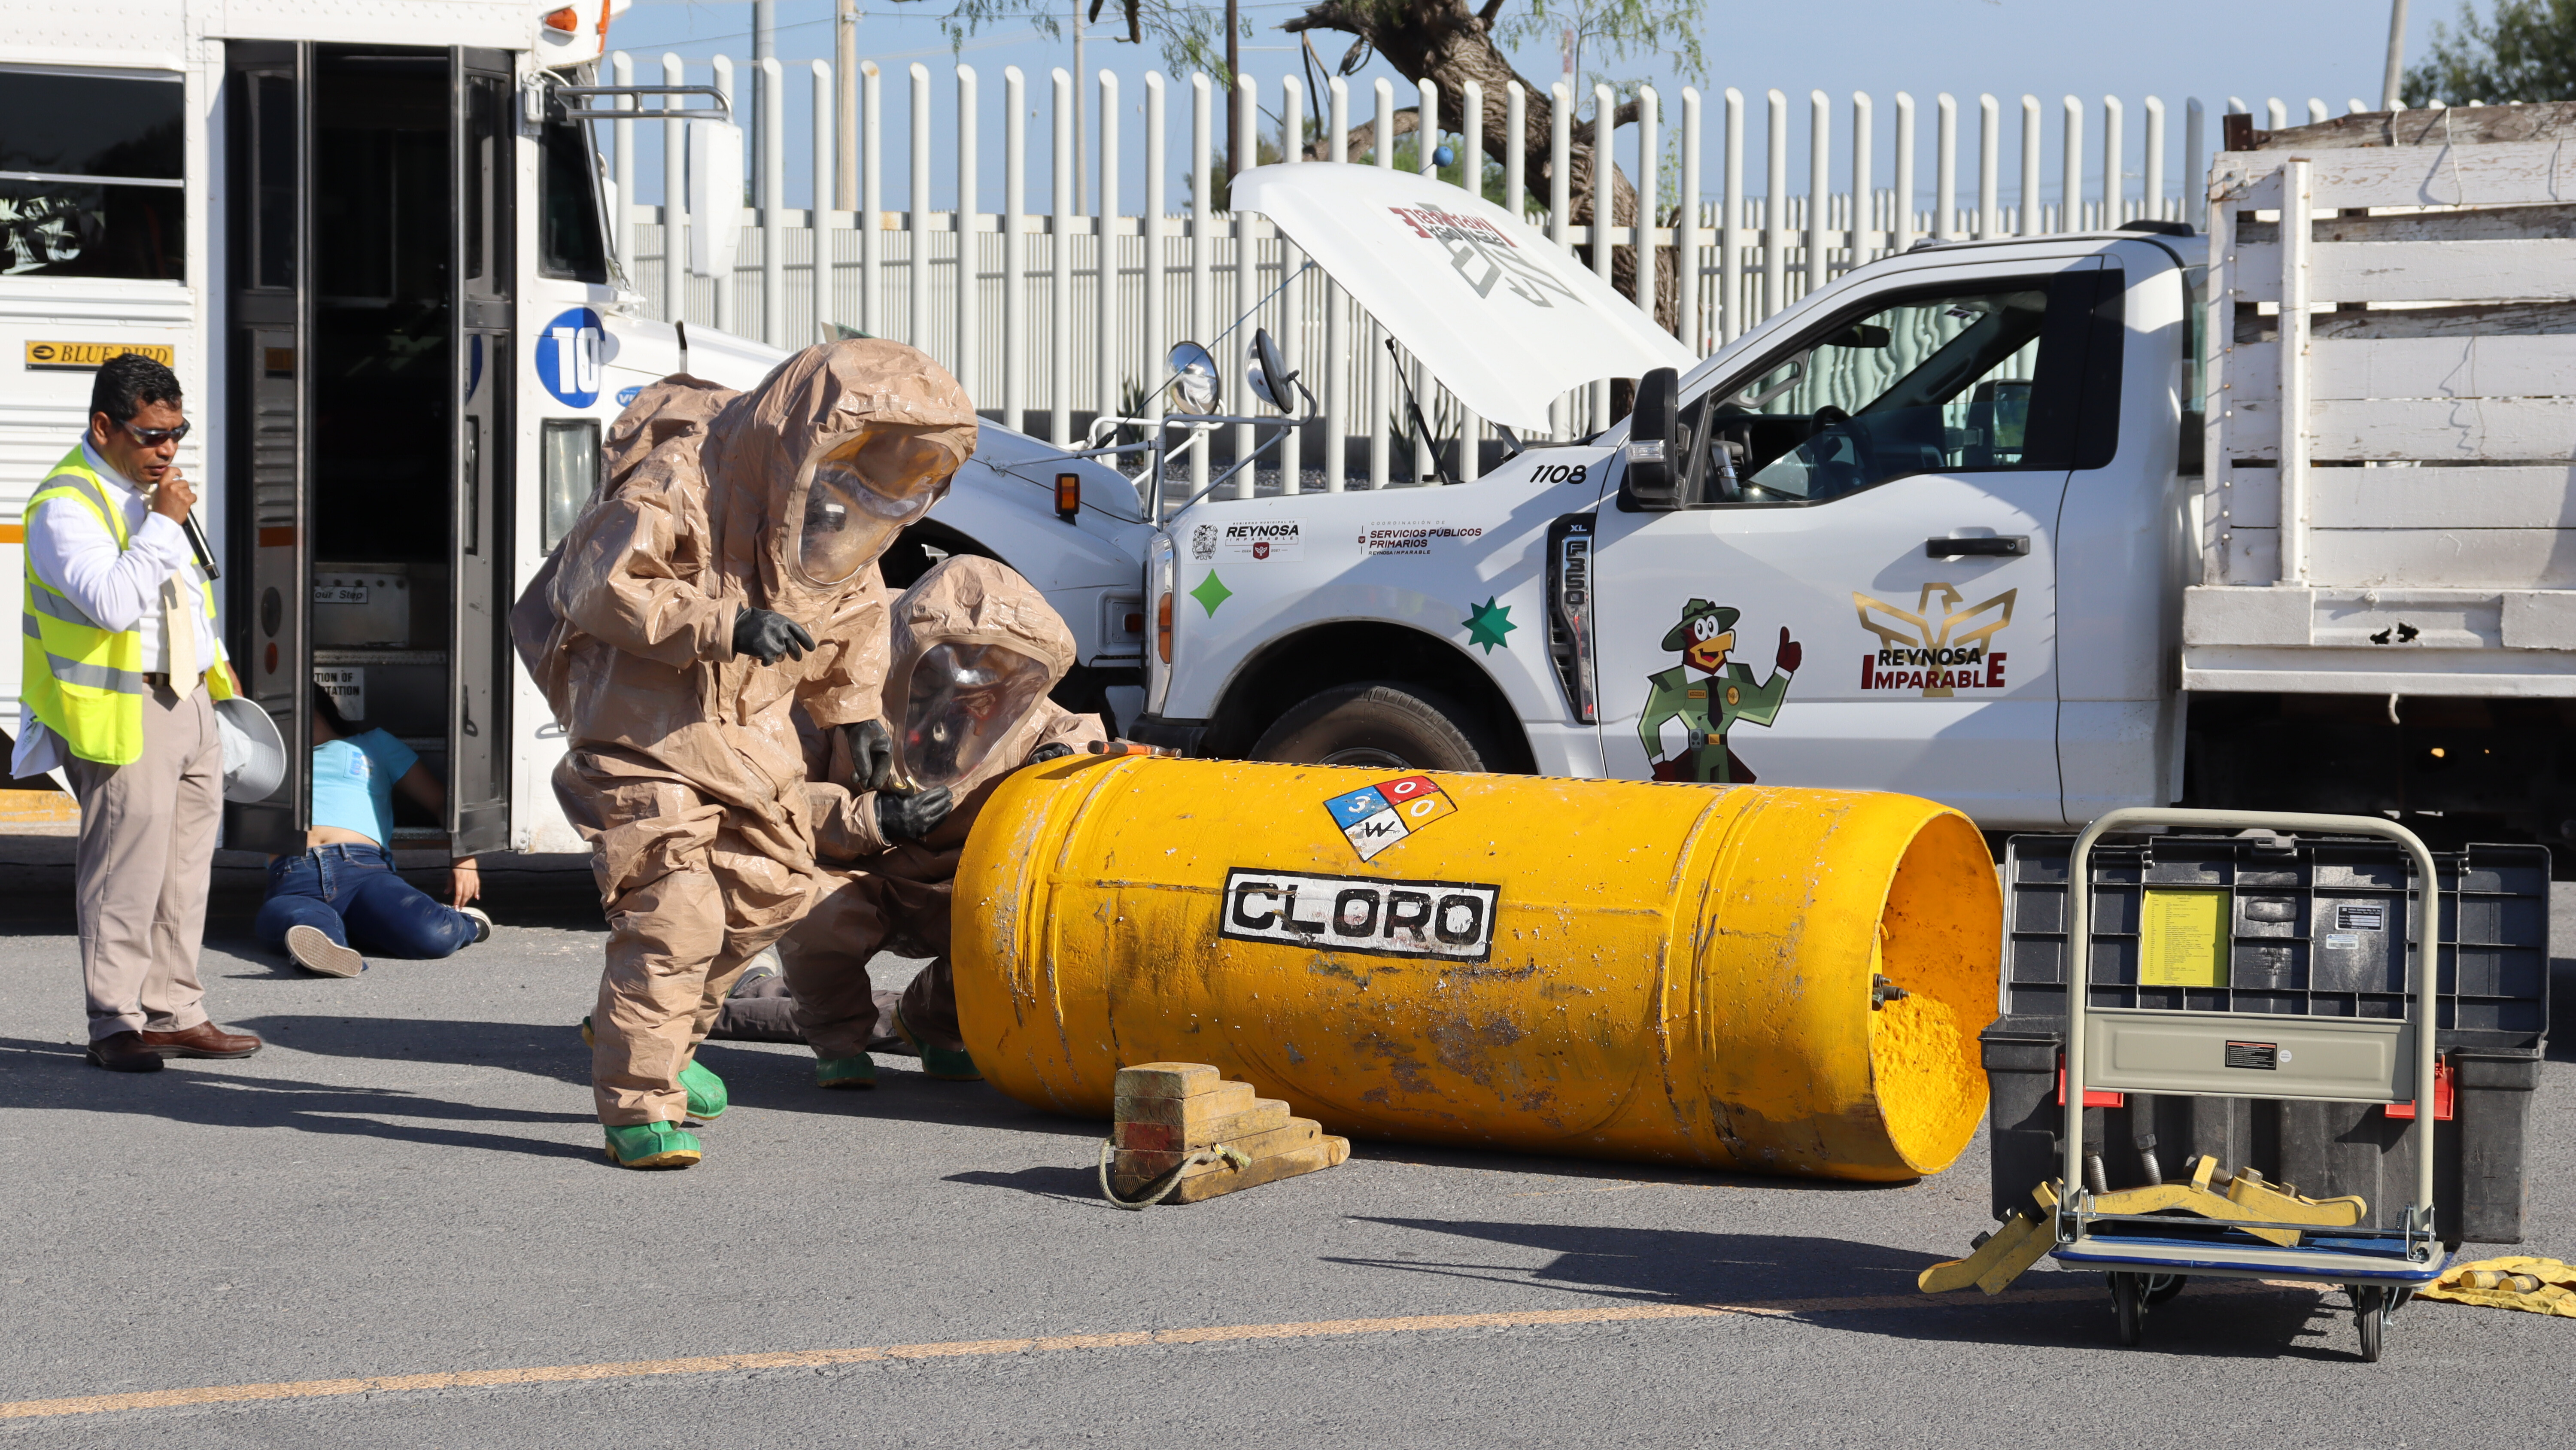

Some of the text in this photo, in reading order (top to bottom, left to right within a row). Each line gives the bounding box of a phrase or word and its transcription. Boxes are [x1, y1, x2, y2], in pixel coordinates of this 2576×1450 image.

[60, 345, 113, 362] BLUE
[552, 327, 601, 394] 10
[1530, 465, 1586, 484] 1108
[1226, 525, 1299, 537] REYNOSA
[1370, 527, 1482, 538] SERVICIOS PÚBLICOS
[1369, 539, 1428, 548] PRIMARIOS
[1566, 541, 1587, 605] F350
[314, 590, 363, 601] our Step
[1878, 647, 1982, 666] REYNOSA
[314, 673, 352, 682] TION OF
[1861, 652, 2007, 690] IMPARABLE
[322, 686, 359, 696] TATION
[1348, 796, 1371, 813] 3
[1364, 821, 1395, 838] W
[1232, 881, 1484, 945] CLORO
